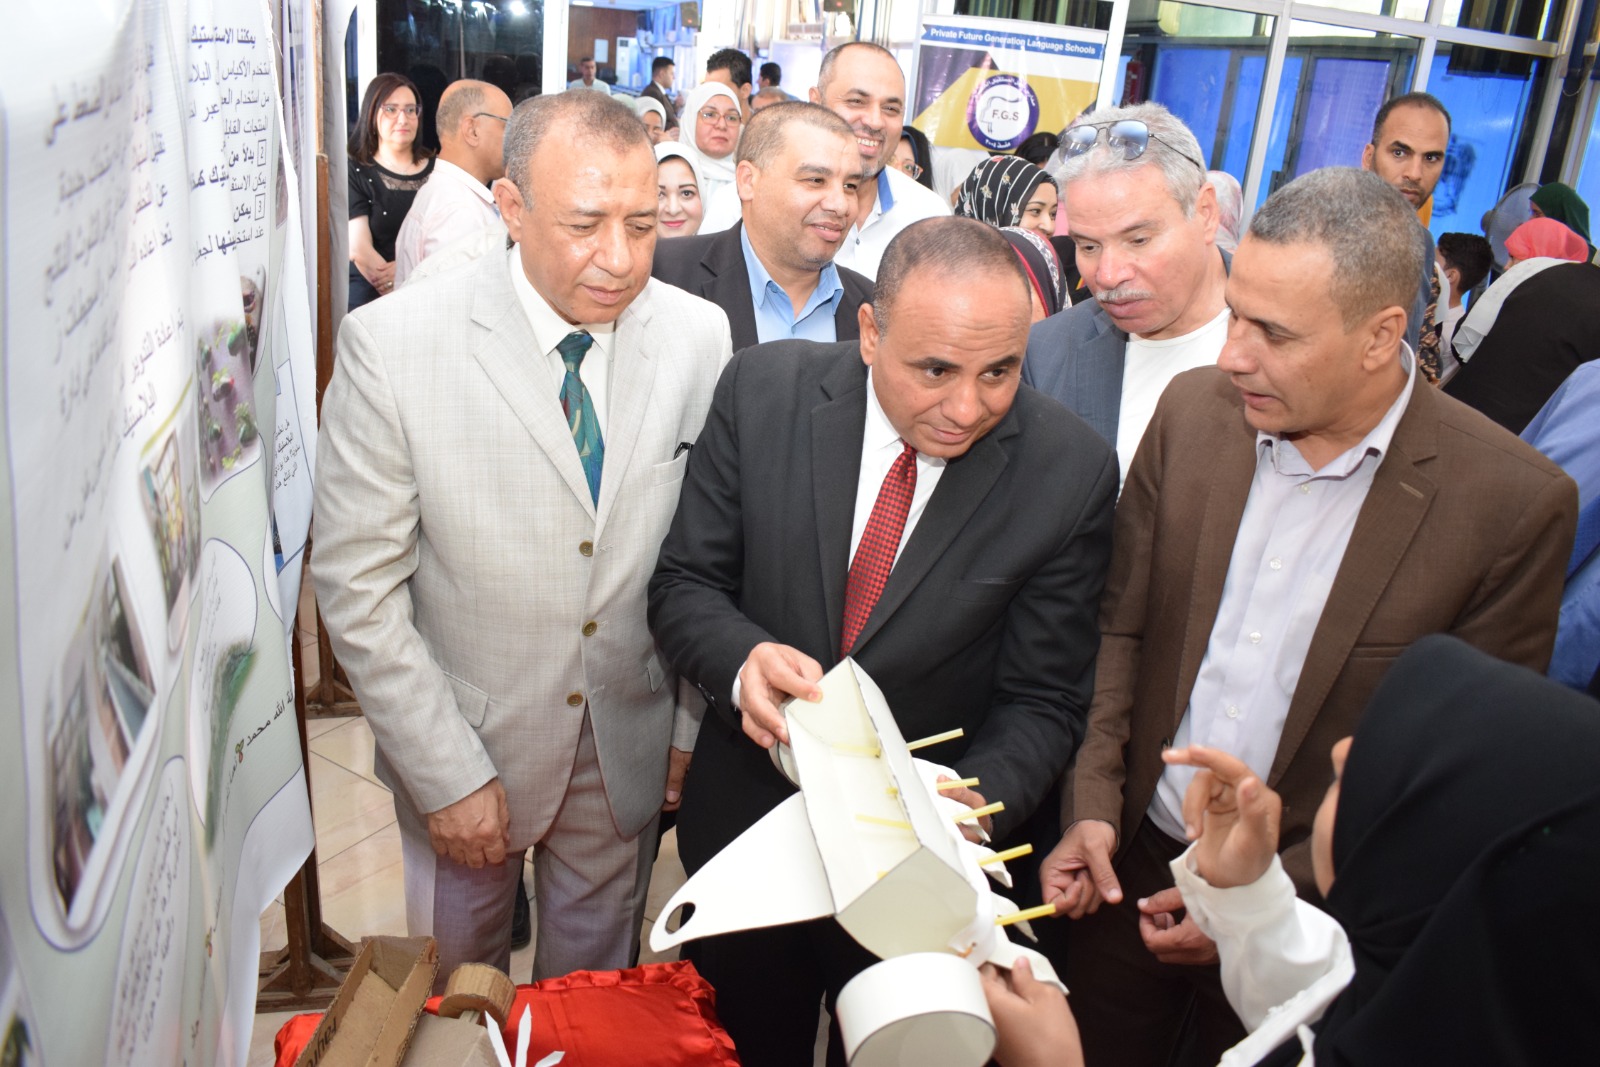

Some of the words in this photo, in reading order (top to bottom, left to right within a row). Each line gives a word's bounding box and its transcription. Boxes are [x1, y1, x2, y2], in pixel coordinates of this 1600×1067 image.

[930, 28, 958, 39] Private
[958, 31, 984, 42] Future
[984, 34, 1026, 46] Generation
[1027, 39, 1064, 52] Language
[1064, 43, 1097, 55] Schools
[992, 109, 1020, 121] F.G.S
[273, 699, 285, 720] الله
[247, 720, 271, 746] محمد
